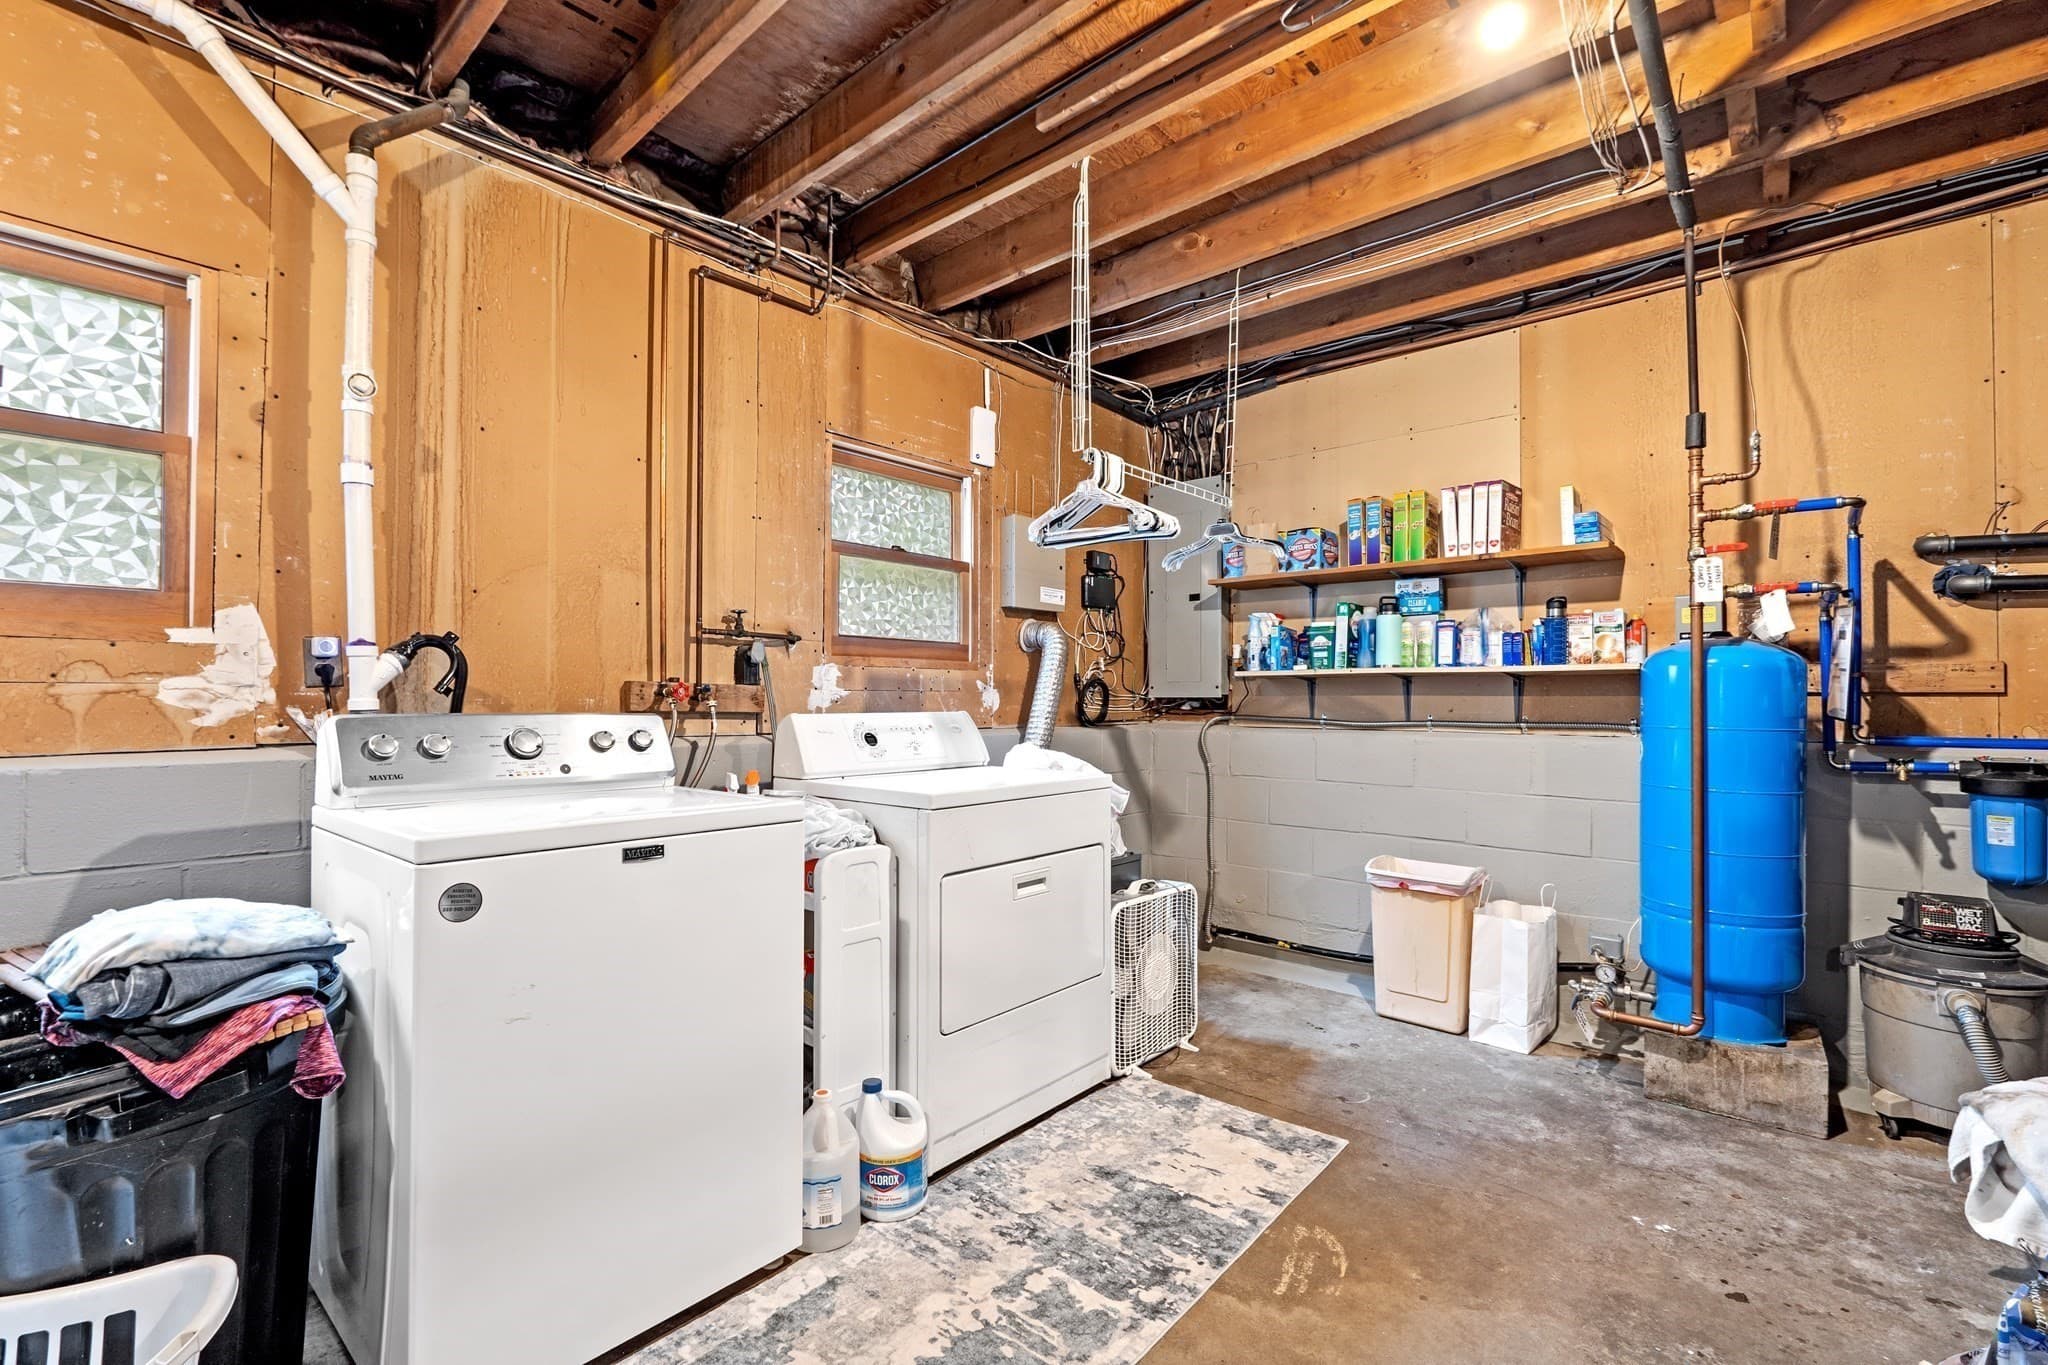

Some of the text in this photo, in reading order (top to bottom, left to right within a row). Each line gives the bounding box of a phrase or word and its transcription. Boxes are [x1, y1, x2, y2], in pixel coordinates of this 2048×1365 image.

[368, 773, 405, 782] MAYTAG
[1953, 907, 1983, 918] WET
[1956, 915, 1983, 925] DRY
[1958, 922, 1982, 932] VAC
[868, 1173, 900, 1186] CLOROX
